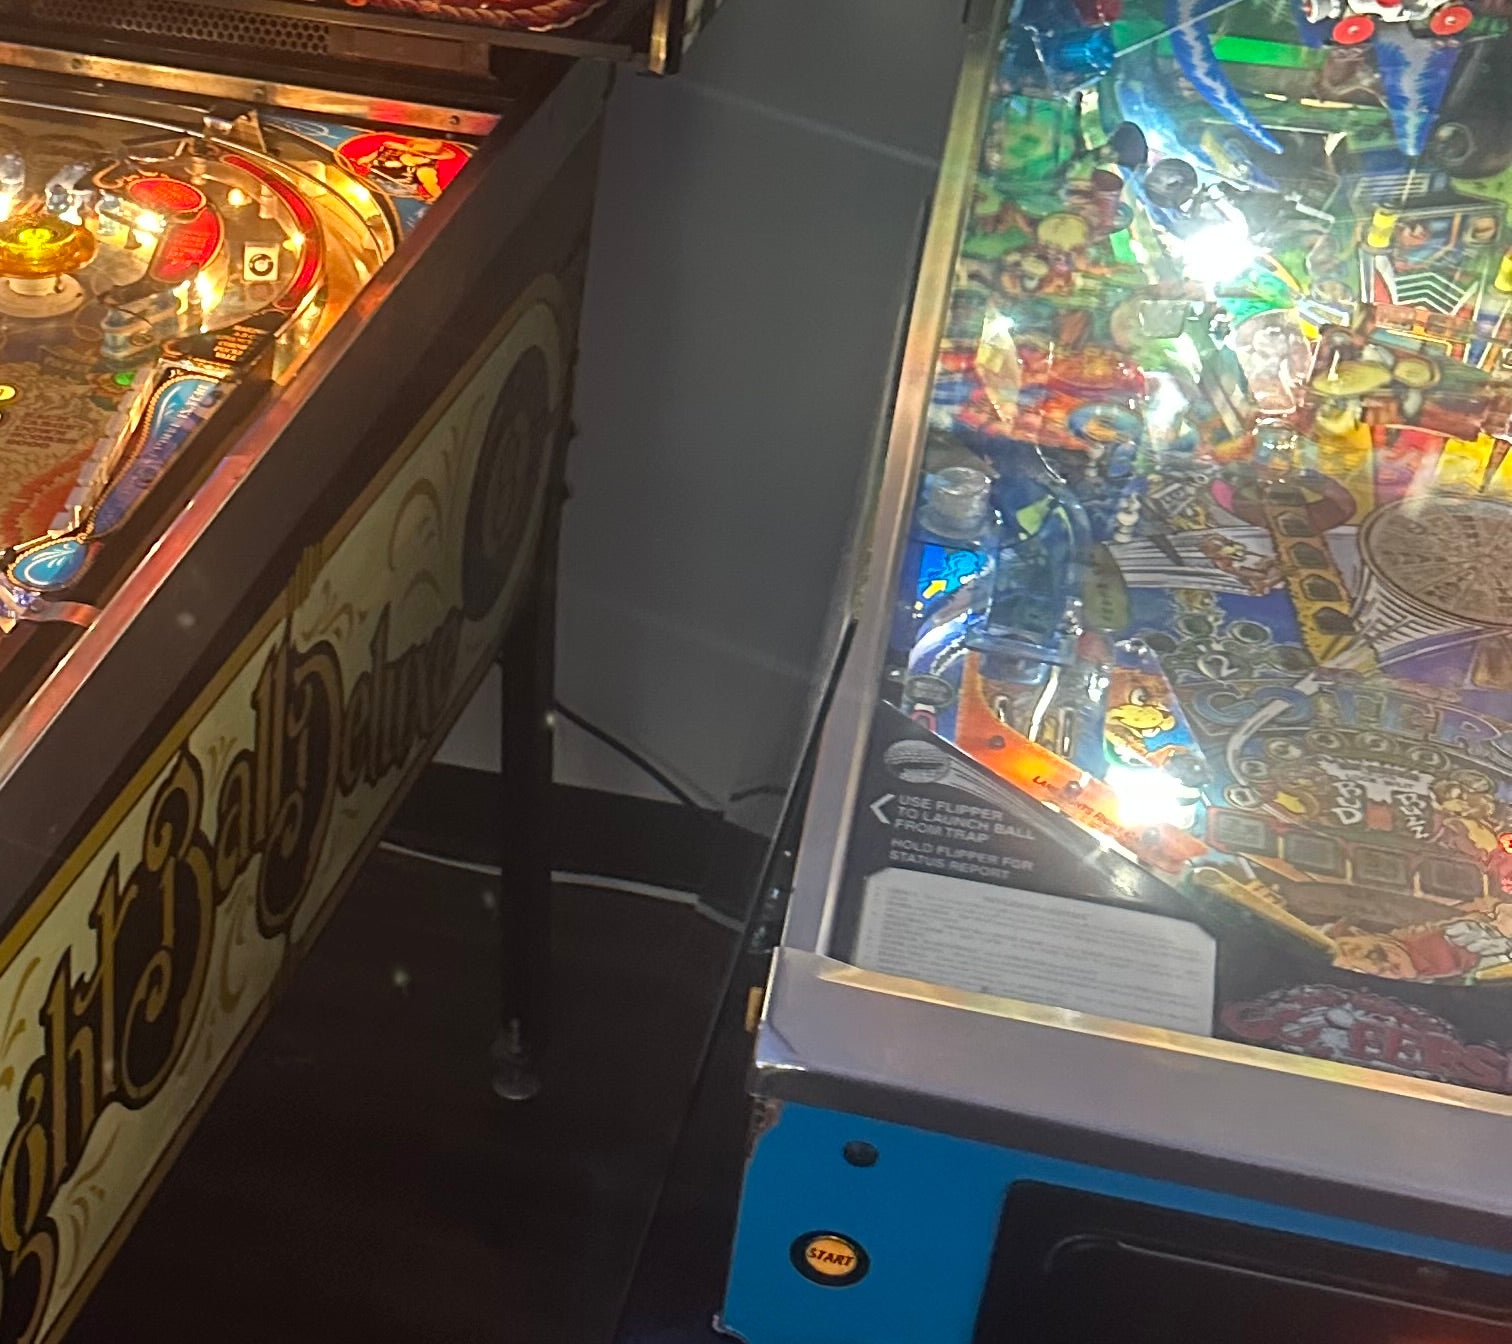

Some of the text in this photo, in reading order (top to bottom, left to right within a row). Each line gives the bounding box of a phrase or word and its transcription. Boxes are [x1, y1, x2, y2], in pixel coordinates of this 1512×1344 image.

[897, 806, 1037, 841] TO LAUNCH BALL
[898, 794, 1003, 822] USE FLIPPER
[894, 818, 989, 844] FROM TRAP
[118, 646, 292, 1106] Ball
[256, 606, 462, 936] Deluxe
[889, 849, 1012, 880] STATUS REPORT
[890, 838, 1034, 872] HOLD FLIPPER FOR
[809, 1247, 855, 1267] START
